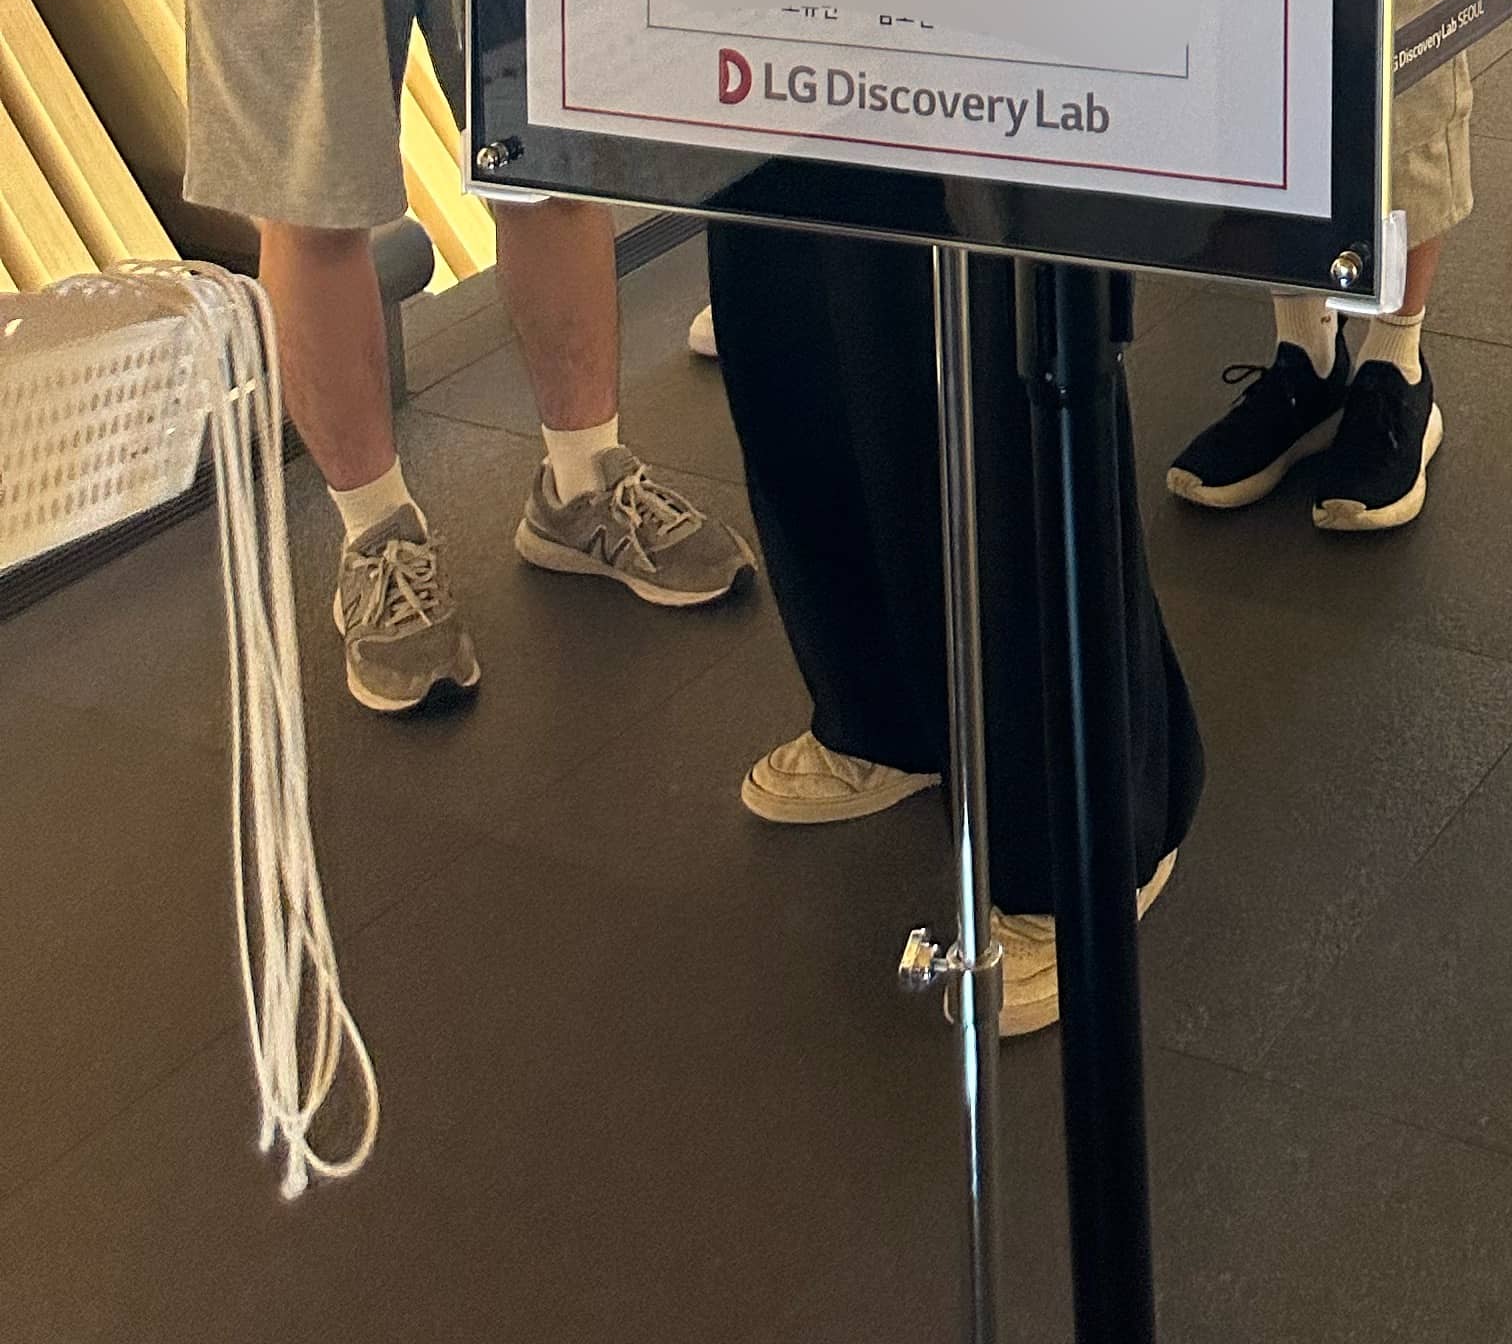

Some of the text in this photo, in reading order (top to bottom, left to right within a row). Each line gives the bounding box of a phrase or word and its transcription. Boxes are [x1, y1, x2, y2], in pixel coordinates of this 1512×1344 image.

[1399, 29, 1442, 69] Discovery
[1441, 16, 1458, 40] Lab
[1457, 0, 1485, 28] SEOUL
[763, 62, 818, 104] LG
[826, 67, 1029, 138] Discovery
[1035, 88, 1111, 135] Lab
